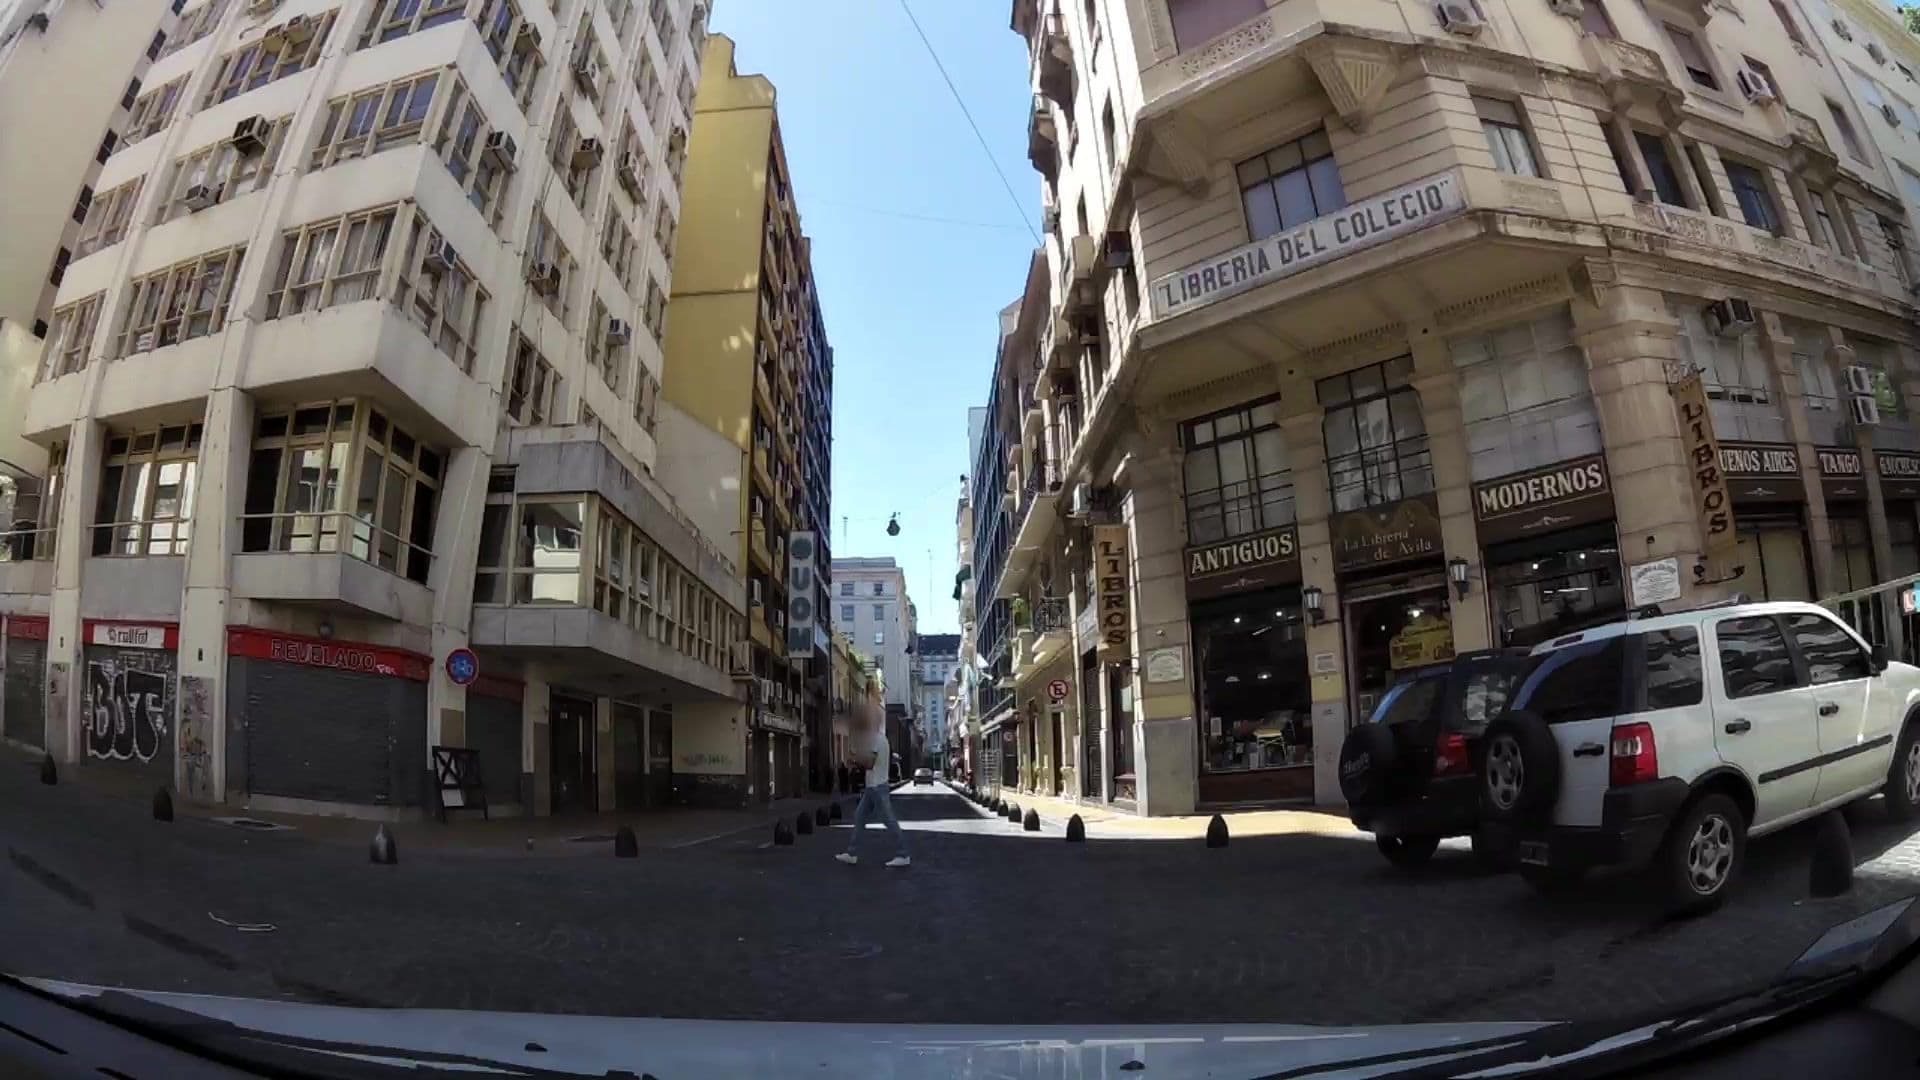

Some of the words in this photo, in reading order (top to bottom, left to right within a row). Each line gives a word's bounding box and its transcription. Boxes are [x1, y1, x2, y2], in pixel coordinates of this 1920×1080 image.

[1278, 228, 1326, 265] DEL
[1682, 402, 1729, 535] LIBROS
[1718, 450, 1761, 473] UENOS
[1763, 451, 1798, 473] AIRES
[1819, 453, 1860, 474] TANGO
[1479, 463, 1604, 514] MODERNOS
[1190, 533, 1294, 575] ANTIGUOS
[1374, 547, 1392, 560] de
[1098, 541, 1127, 645] LIBROS
[271, 638, 377, 672] REVELADO
